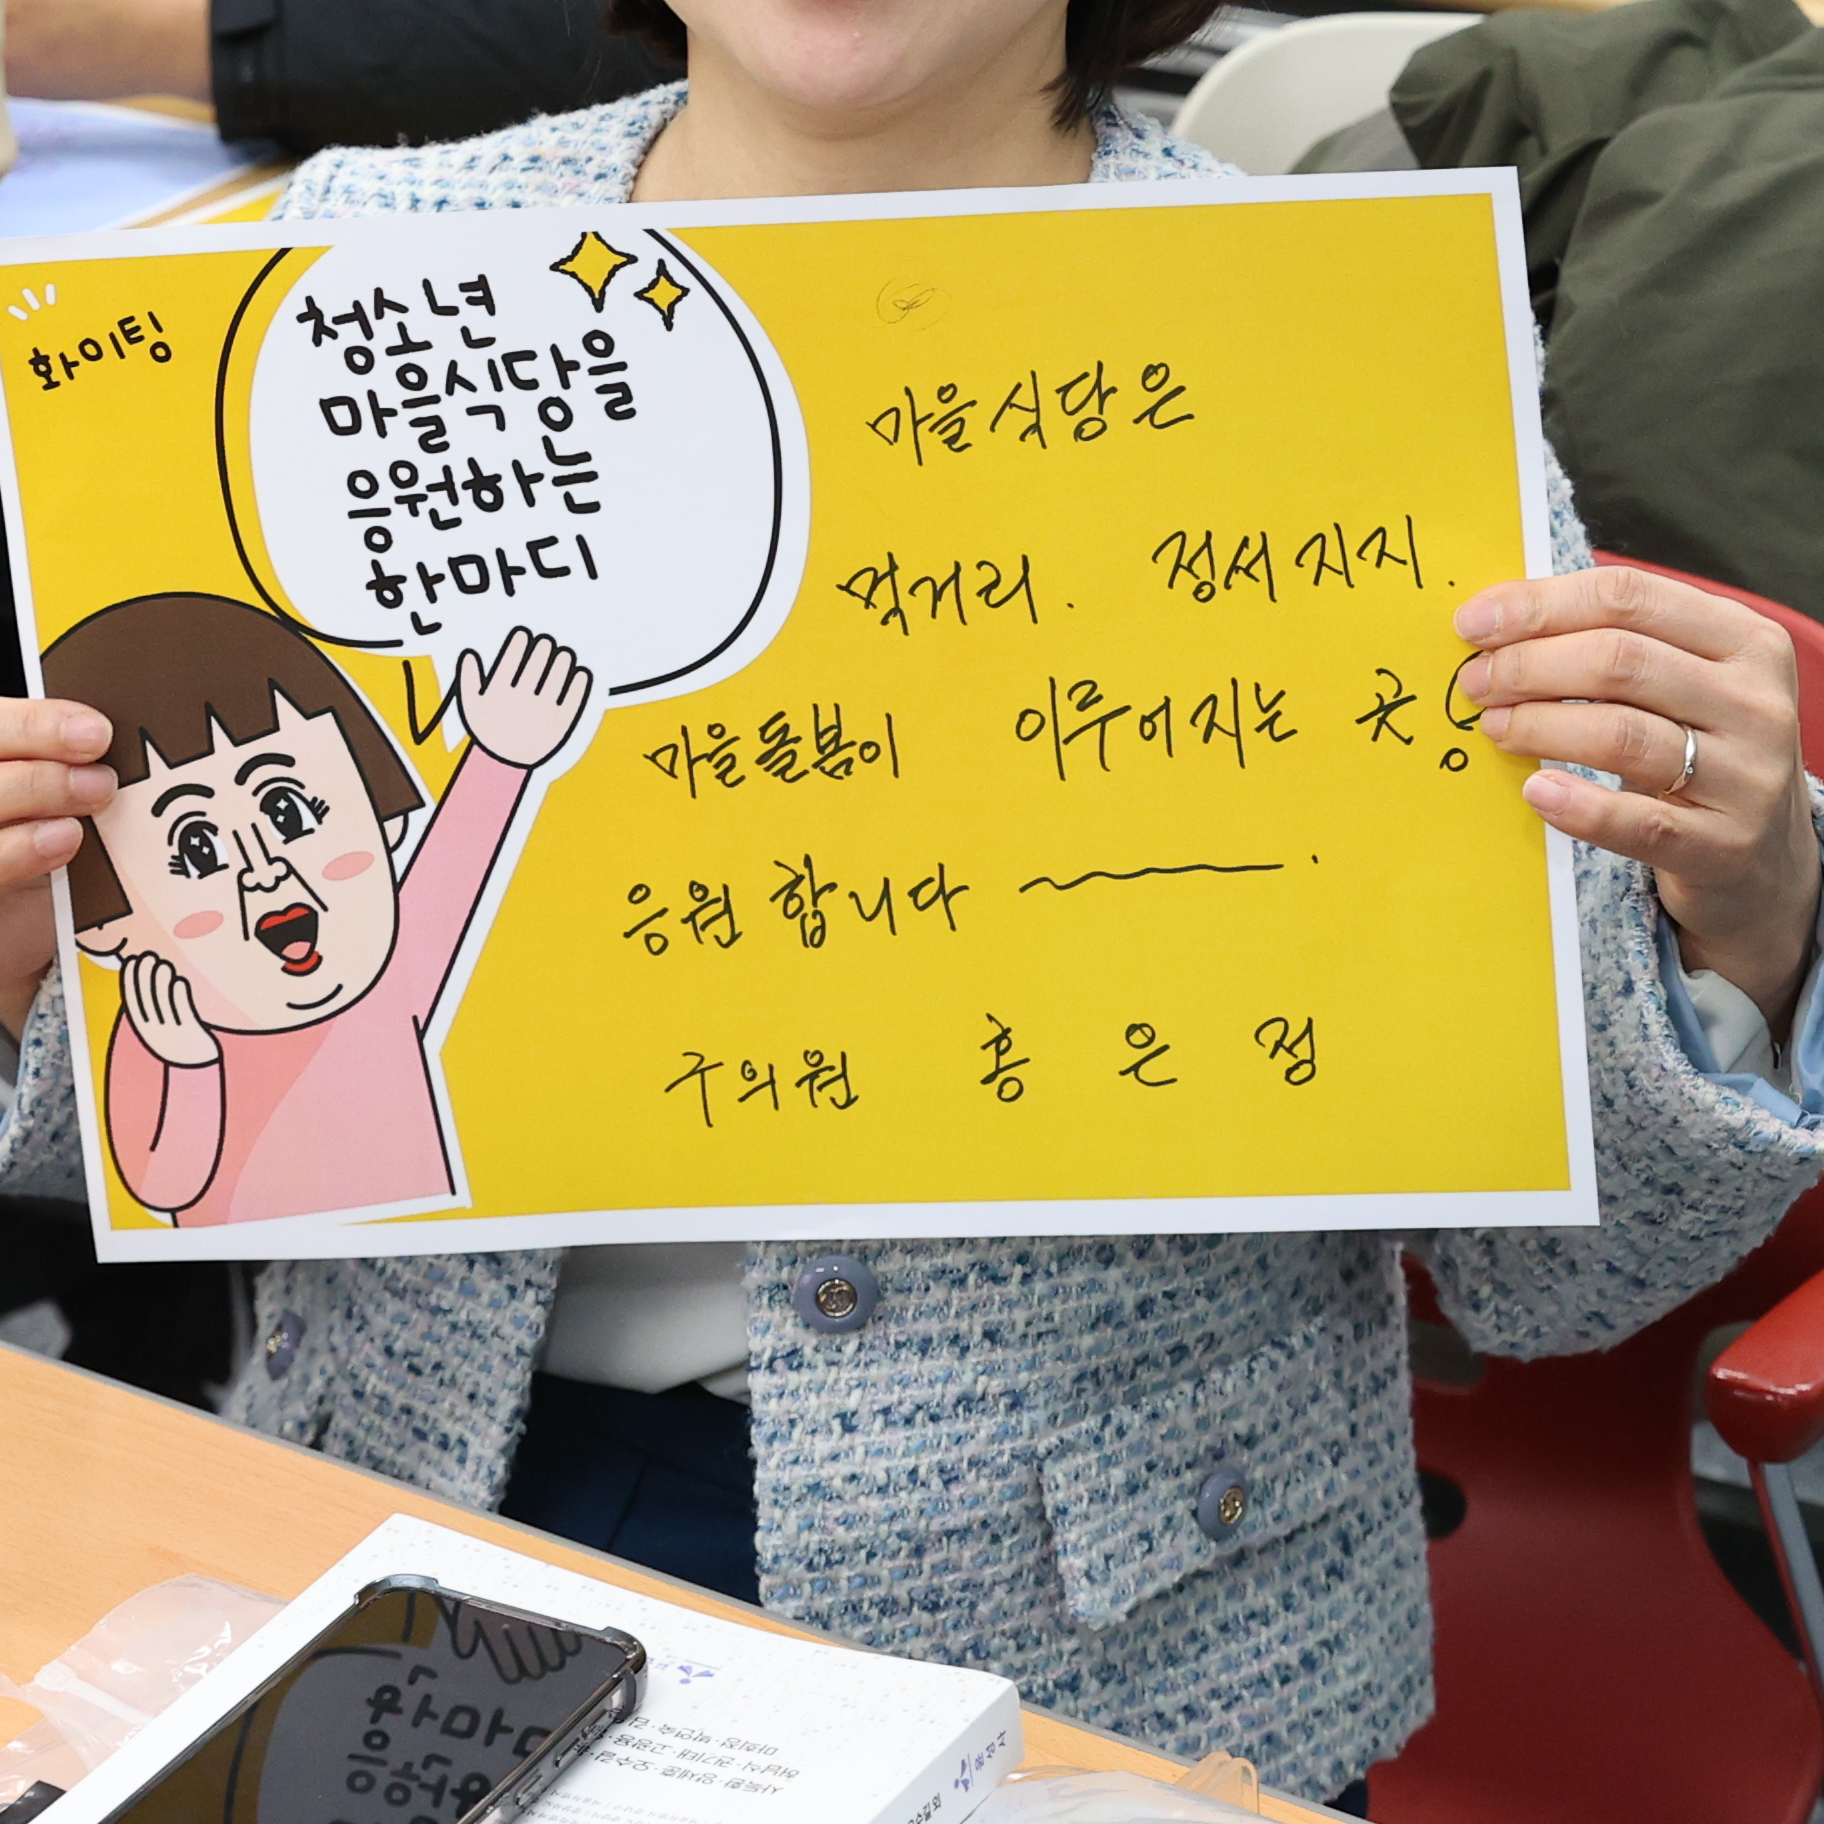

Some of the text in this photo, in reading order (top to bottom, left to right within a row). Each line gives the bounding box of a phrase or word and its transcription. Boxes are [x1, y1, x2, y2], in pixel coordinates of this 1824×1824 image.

[28, 310, 172, 392] 화이팅
[296, 273, 497, 376] 청소년
[318, 329, 637, 455] 마을식당을
[346, 434, 602, 554] 응원하는
[365, 533, 598, 636] 한마디
[1015, 676, 1298, 782] 이루어지는
